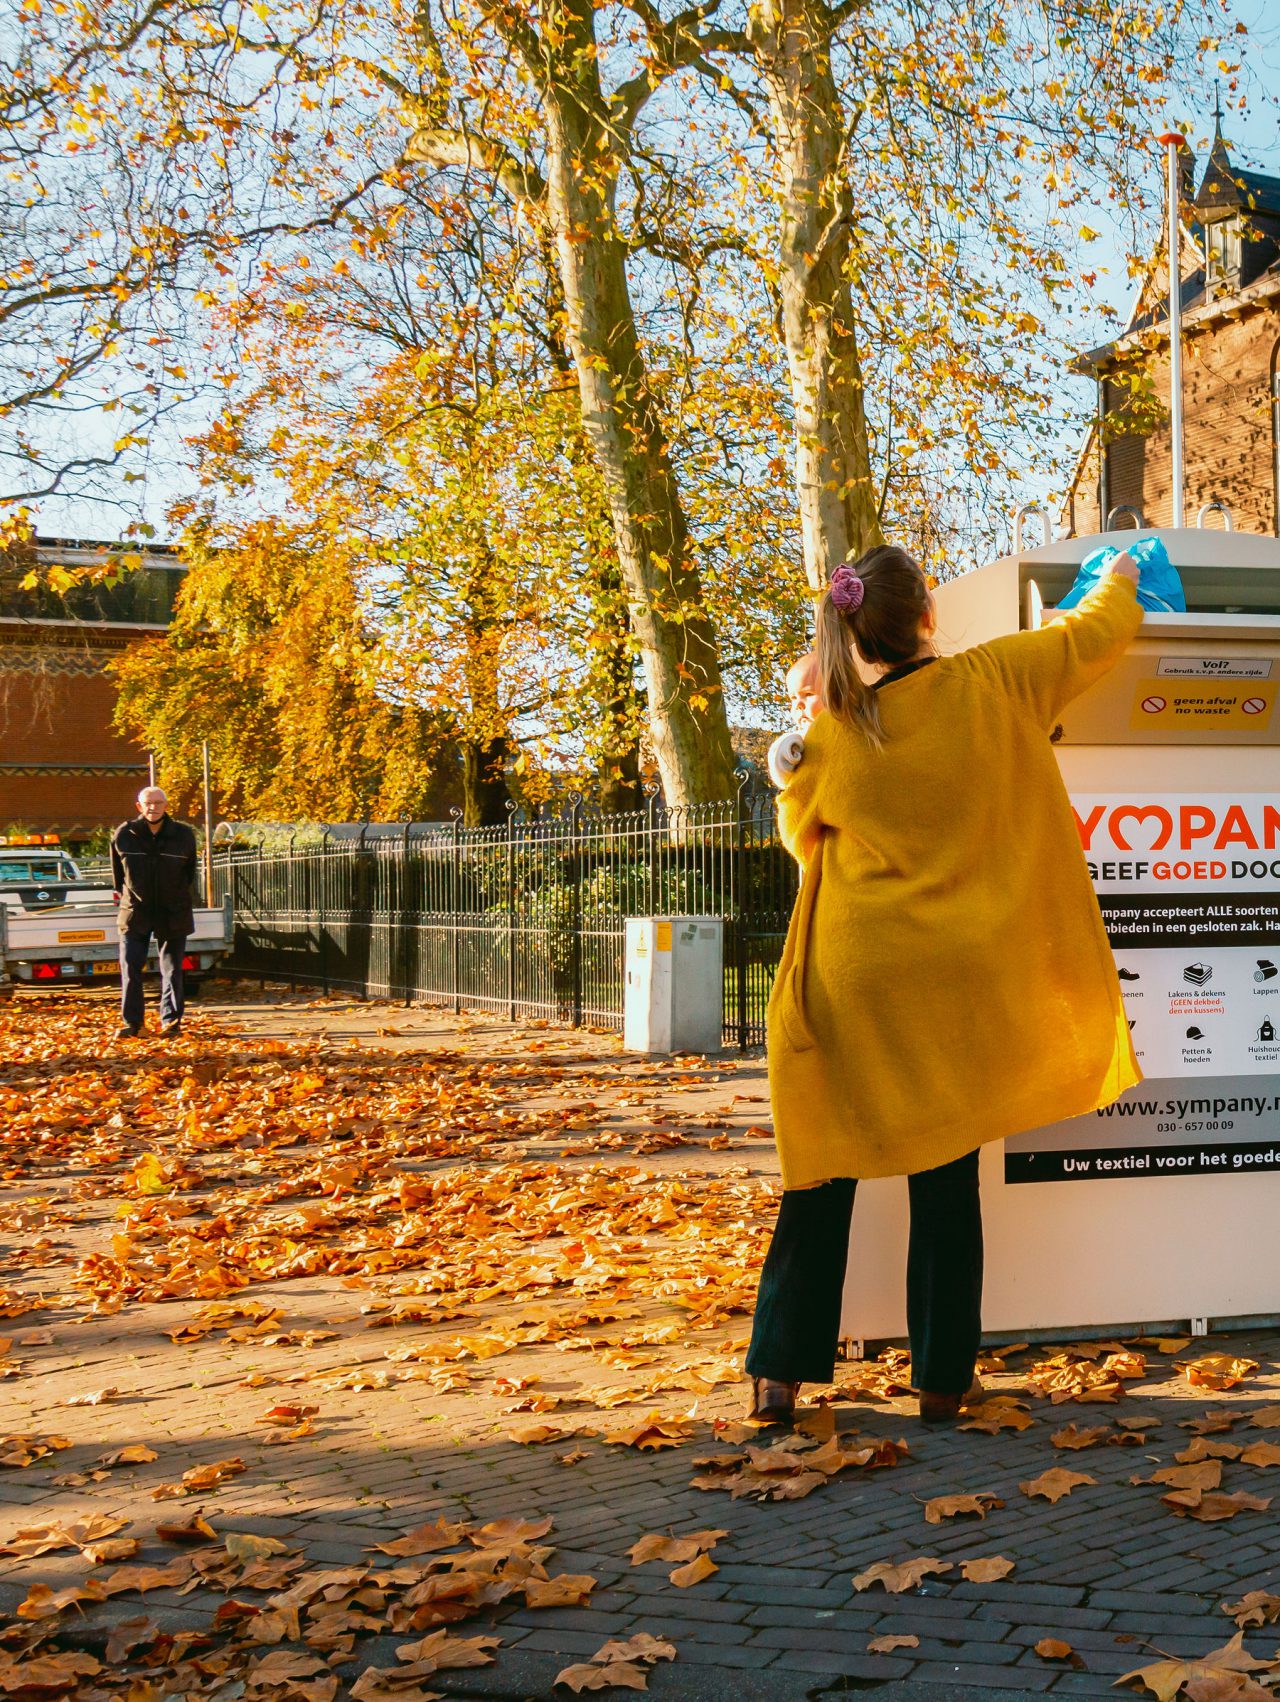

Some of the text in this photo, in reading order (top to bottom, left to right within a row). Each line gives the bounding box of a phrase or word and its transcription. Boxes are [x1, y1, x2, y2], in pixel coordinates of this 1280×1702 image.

[1203, 661, 1229, 669] Vol?
[1174, 697, 1237, 706] geen afval
[1143, 907, 1205, 919] accepteert
[1206, 905, 1233, 916] ALLE
[1235, 905, 1279, 916] soorten
[1152, 922, 1163, 933] in
[1166, 924, 1187, 932] een
[1189, 920, 1238, 934] gesloten
[1240, 920, 1263, 932] zak.
[1253, 988, 1279, 996] Lappen
[1170, 998, 1223, 1007] (GEEN dekbed-
[1169, 1007, 1182, 1015] den
[1194, 1006, 1225, 1014] kussens)
[1182, 1048, 1205, 1056] Petten
[1255, 1053, 1278, 1061] textiel
[1157, 1123, 1176, 1132] 030
[1185, 1122, 1204, 1131] 657
[1206, 1122, 1219, 1130] 00
[1221, 1121, 1234, 1130] 09
[1063, 1158, 1090, 1172] Uw
[1096, 1154, 1150, 1170] textiel
[1155, 1155, 1195, 1168] voor
[1200, 1152, 1228, 1166] het
